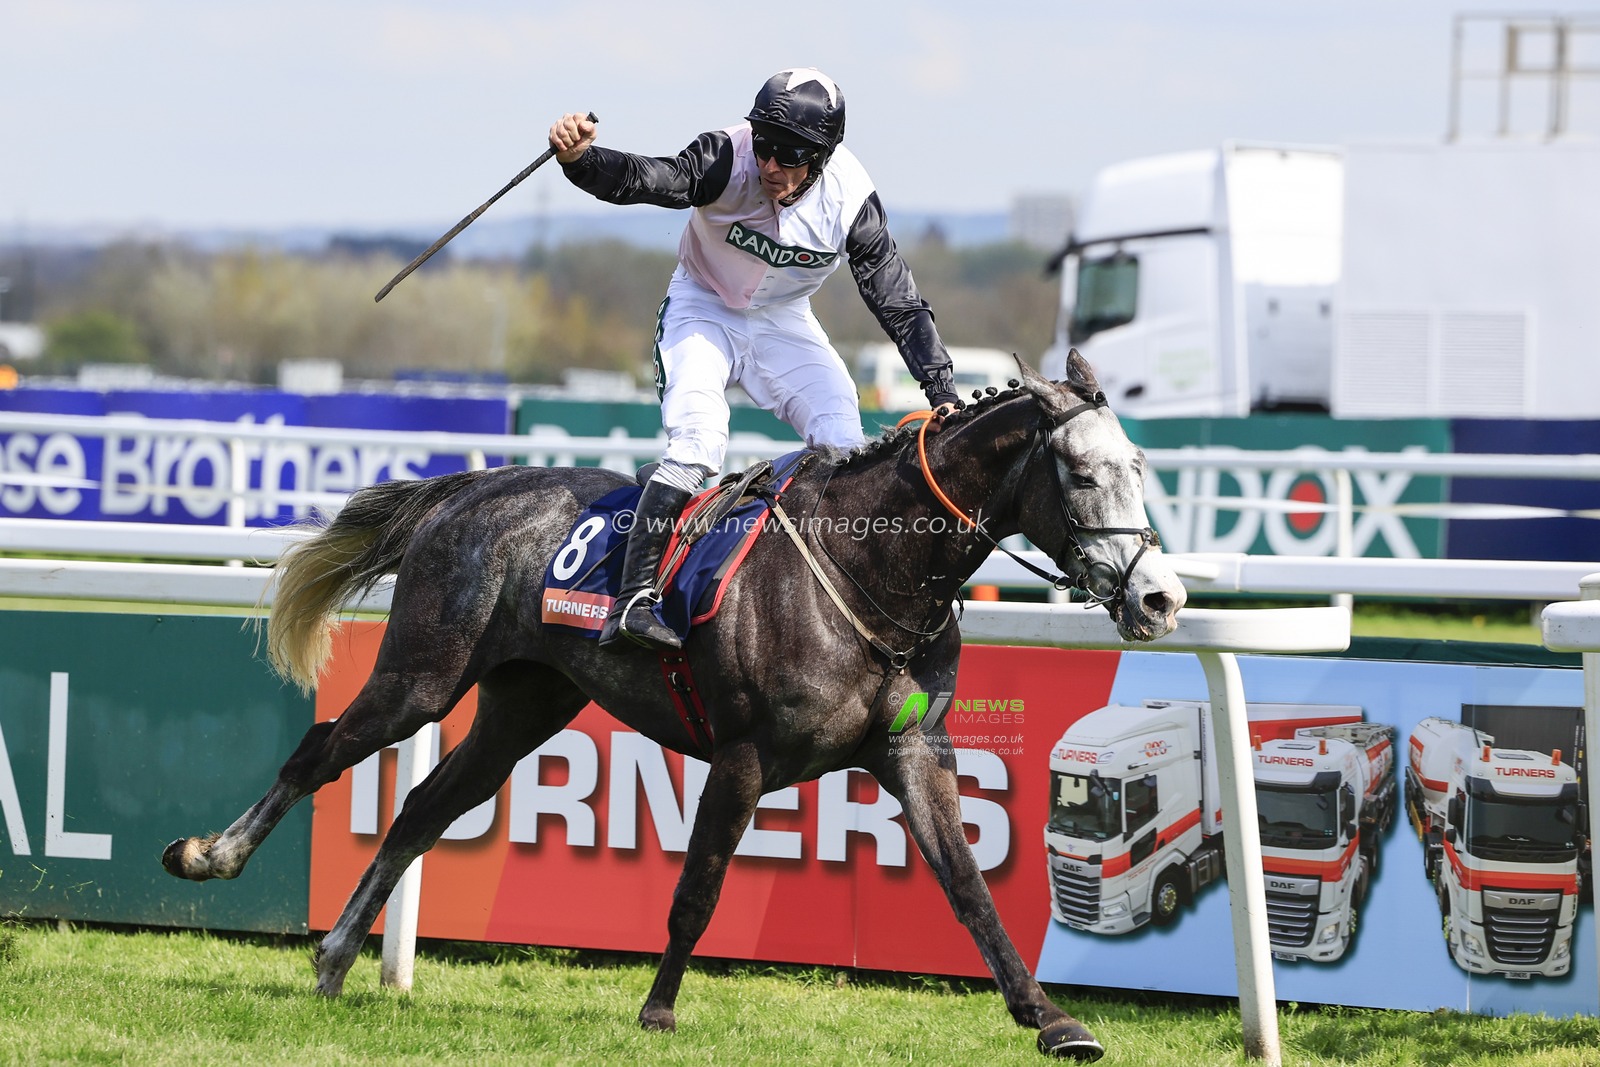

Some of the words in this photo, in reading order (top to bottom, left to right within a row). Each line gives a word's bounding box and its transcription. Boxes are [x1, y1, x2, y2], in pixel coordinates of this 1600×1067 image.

[729, 225, 834, 266] RANDOX
[0, 431, 87, 515] se
[553, 516, 605, 581] 8
[546, 598, 609, 619] TURNERS
[1057, 748, 1098, 764] TURNERS
[1258, 755, 1314, 767] TURNERS
[1495, 767, 1556, 779] TURNERS
[1062, 862, 1083, 873] DAF
[1270, 881, 1296, 890] DAF
[1508, 898, 1536, 906] DAF
